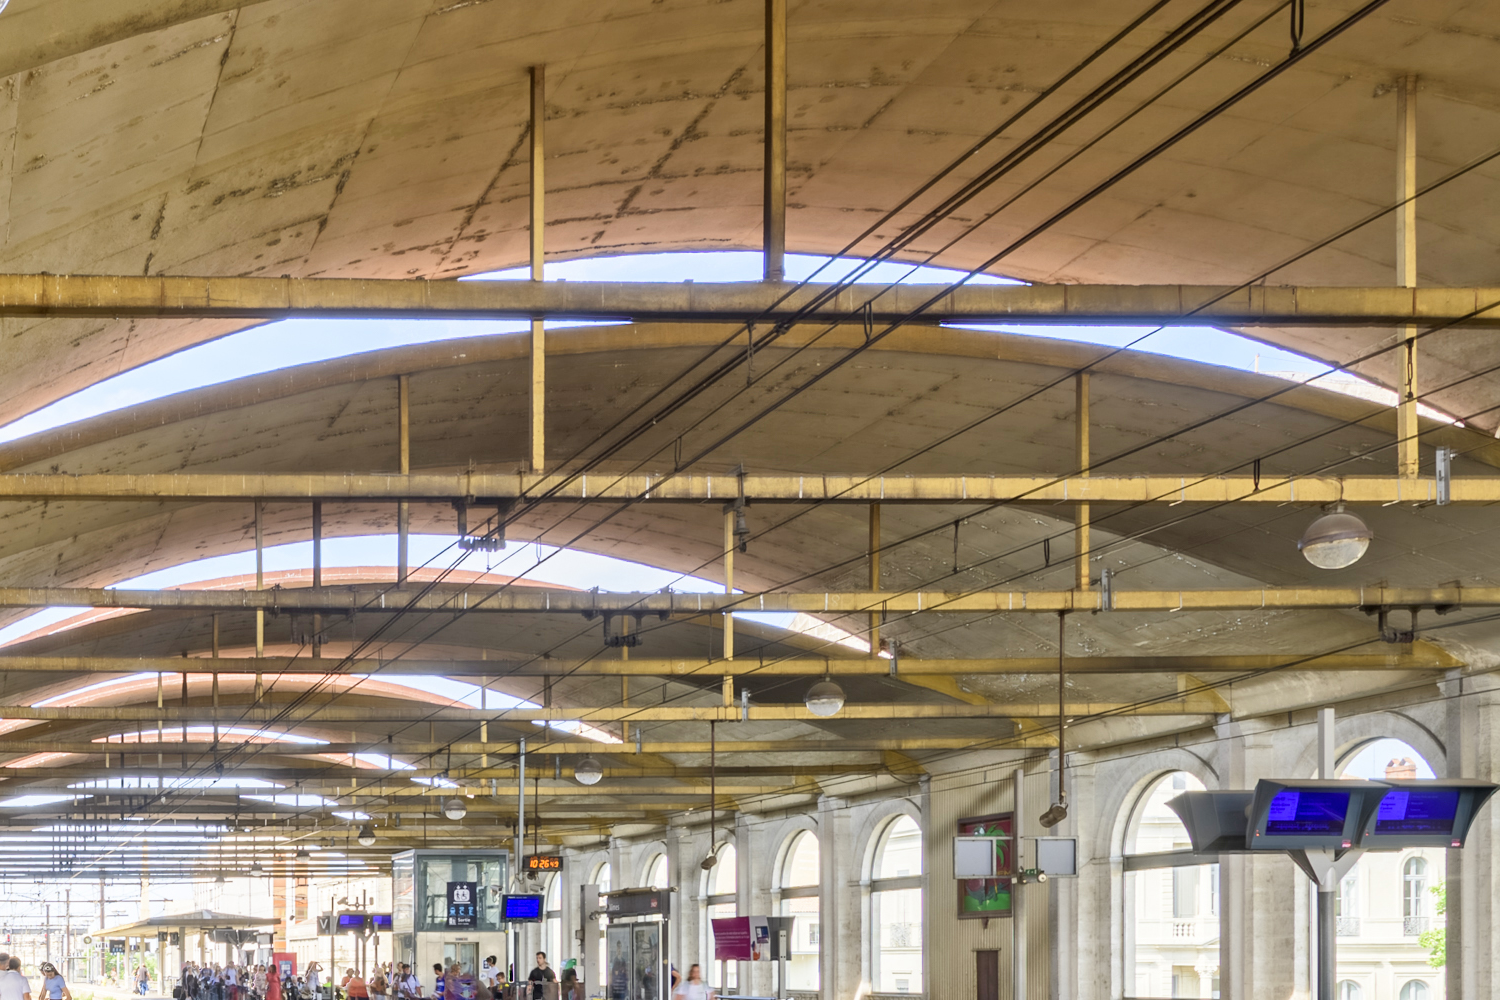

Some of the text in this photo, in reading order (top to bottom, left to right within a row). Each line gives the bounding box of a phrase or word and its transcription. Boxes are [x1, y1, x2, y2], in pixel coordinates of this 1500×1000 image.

[530, 859, 539, 869] 10
[539, 859, 550, 869] 26
[320, 918, 329, 930] V
